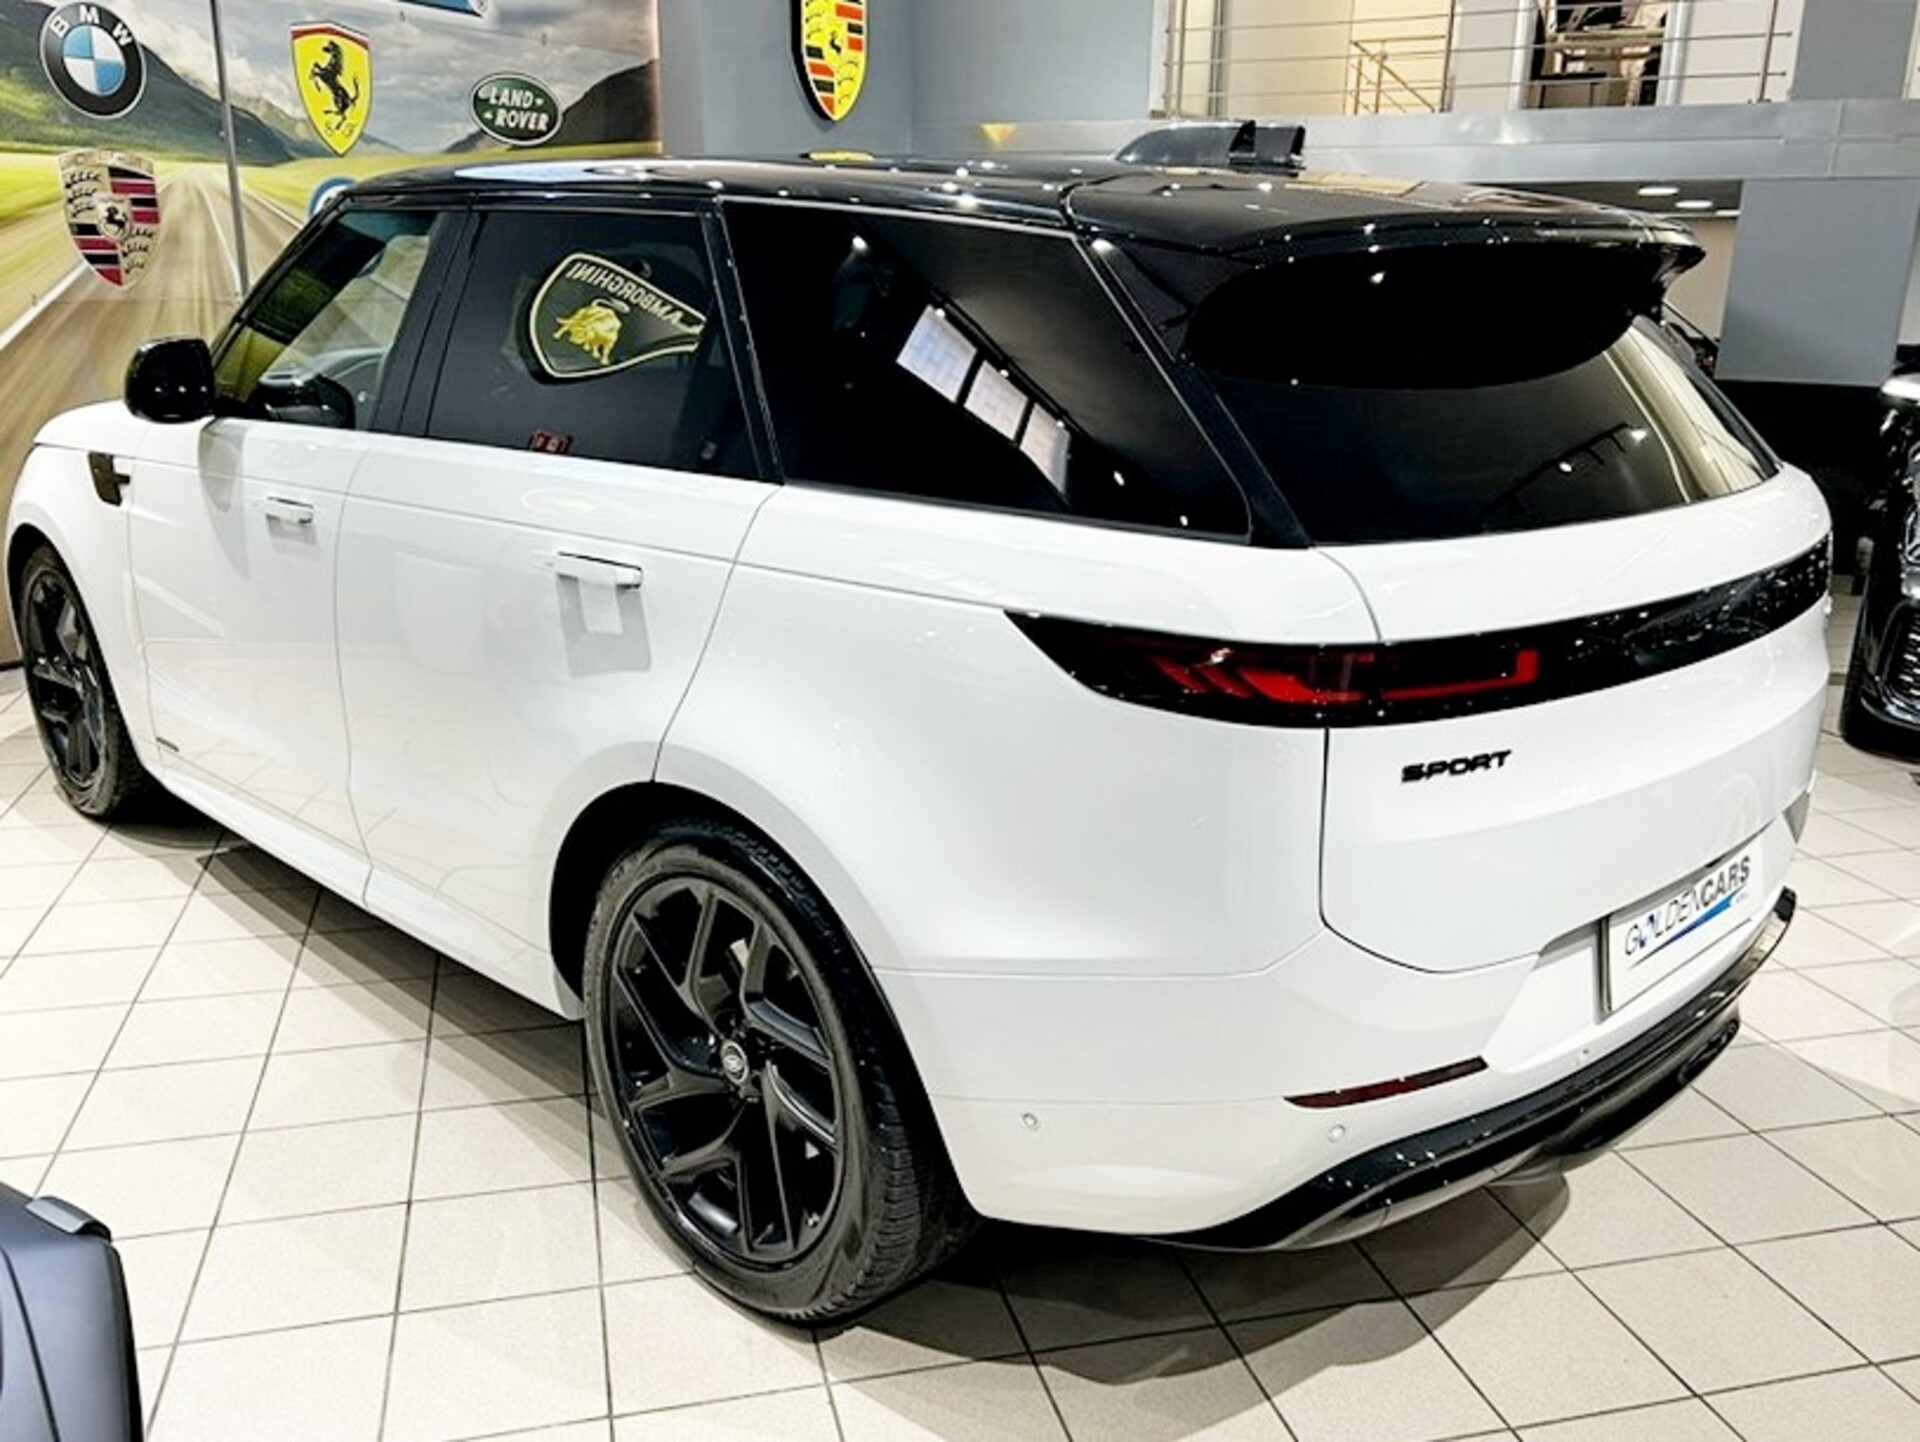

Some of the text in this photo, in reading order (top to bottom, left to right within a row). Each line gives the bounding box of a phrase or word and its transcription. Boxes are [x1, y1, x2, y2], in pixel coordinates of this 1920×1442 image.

[49, 5, 133, 46] BMW
[489, 86, 534, 109] LAND
[494, 108, 549, 132] ROVER
[1401, 749, 1512, 783] SPORT
